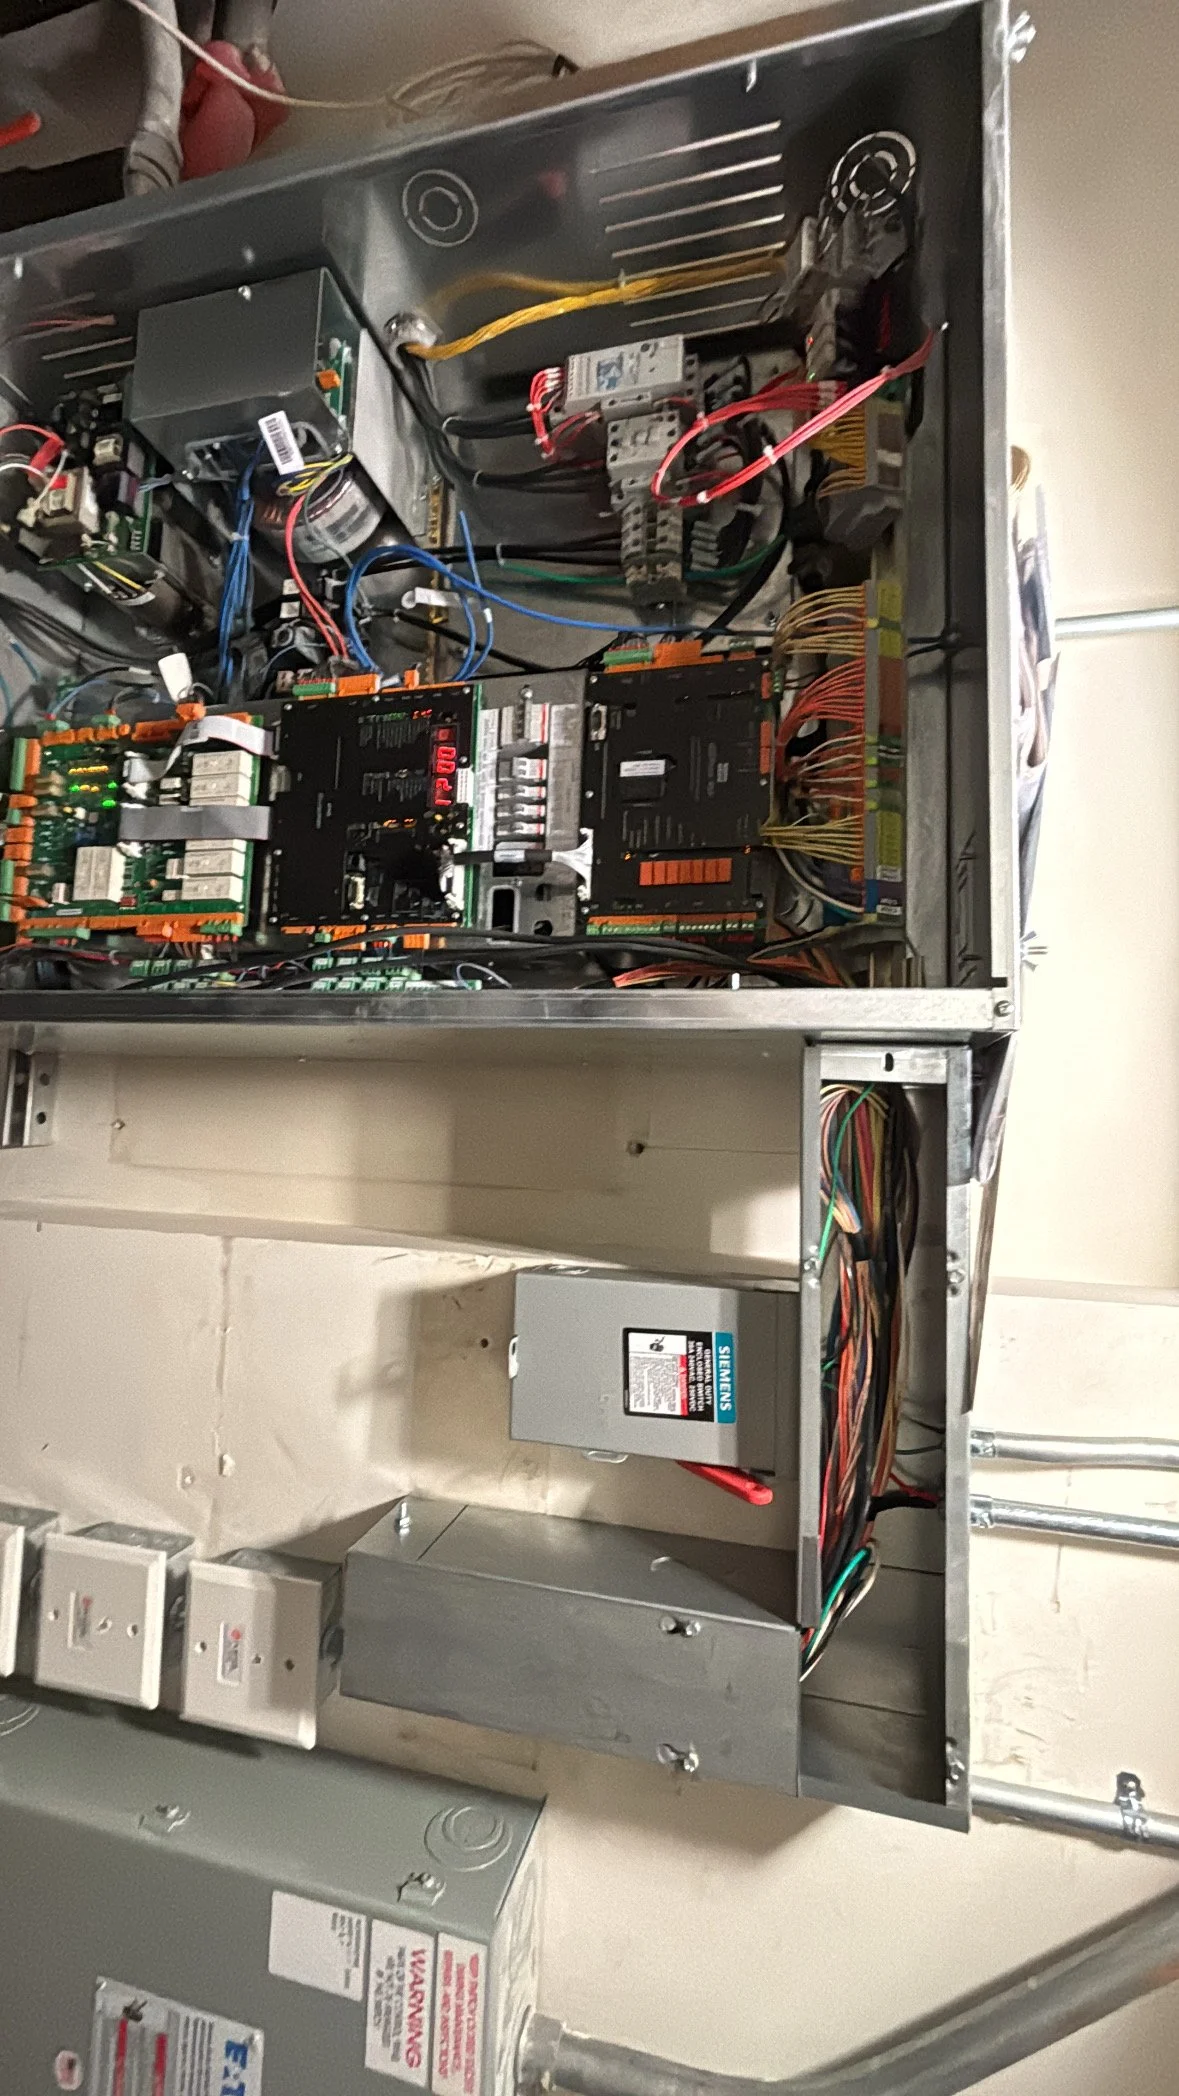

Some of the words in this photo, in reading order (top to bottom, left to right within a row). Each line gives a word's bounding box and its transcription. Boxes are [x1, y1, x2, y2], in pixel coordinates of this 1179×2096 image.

[696, 1341, 704, 1382] ENCLOSED
[704, 1348, 712, 1384] GENERAL
[719, 1345, 732, 1411] SIEMENS
[696, 1383, 704, 1412] SWITCH
[704, 1385, 713, 1406] DUTY
[406, 1949, 426, 2068] WARNING
